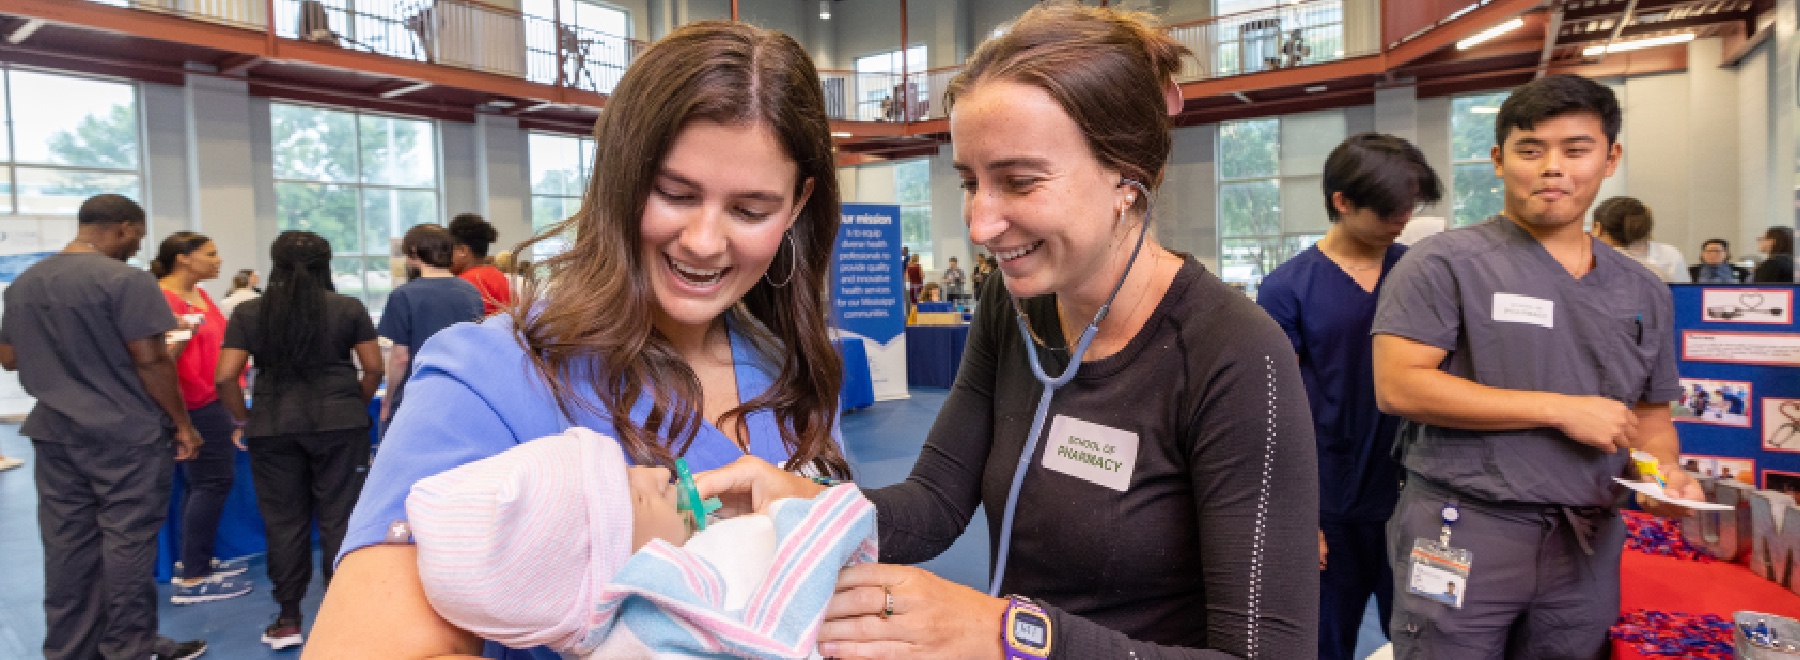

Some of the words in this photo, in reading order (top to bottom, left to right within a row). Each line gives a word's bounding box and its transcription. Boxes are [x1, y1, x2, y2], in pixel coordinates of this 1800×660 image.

[856, 213, 892, 224] mission
[862, 228, 882, 239] equip
[841, 239, 864, 248] diverse
[866, 239, 888, 248] health
[839, 252, 880, 262] professionals
[881, 252, 891, 261] to
[839, 262, 865, 273] provide
[867, 262, 891, 273] quality
[841, 275, 855, 284] and
[856, 275, 890, 284] innovative
[841, 286, 863, 295] health
[864, 286, 891, 295] services
[835, 298, 846, 307] for
[860, 297, 895, 308] Mississippi
[843, 309, 889, 319] communities.
[1068, 436, 1100, 452] SCHOOL
[1103, 444, 1116, 455] OF
[1058, 444, 1123, 473] PHARMACY
